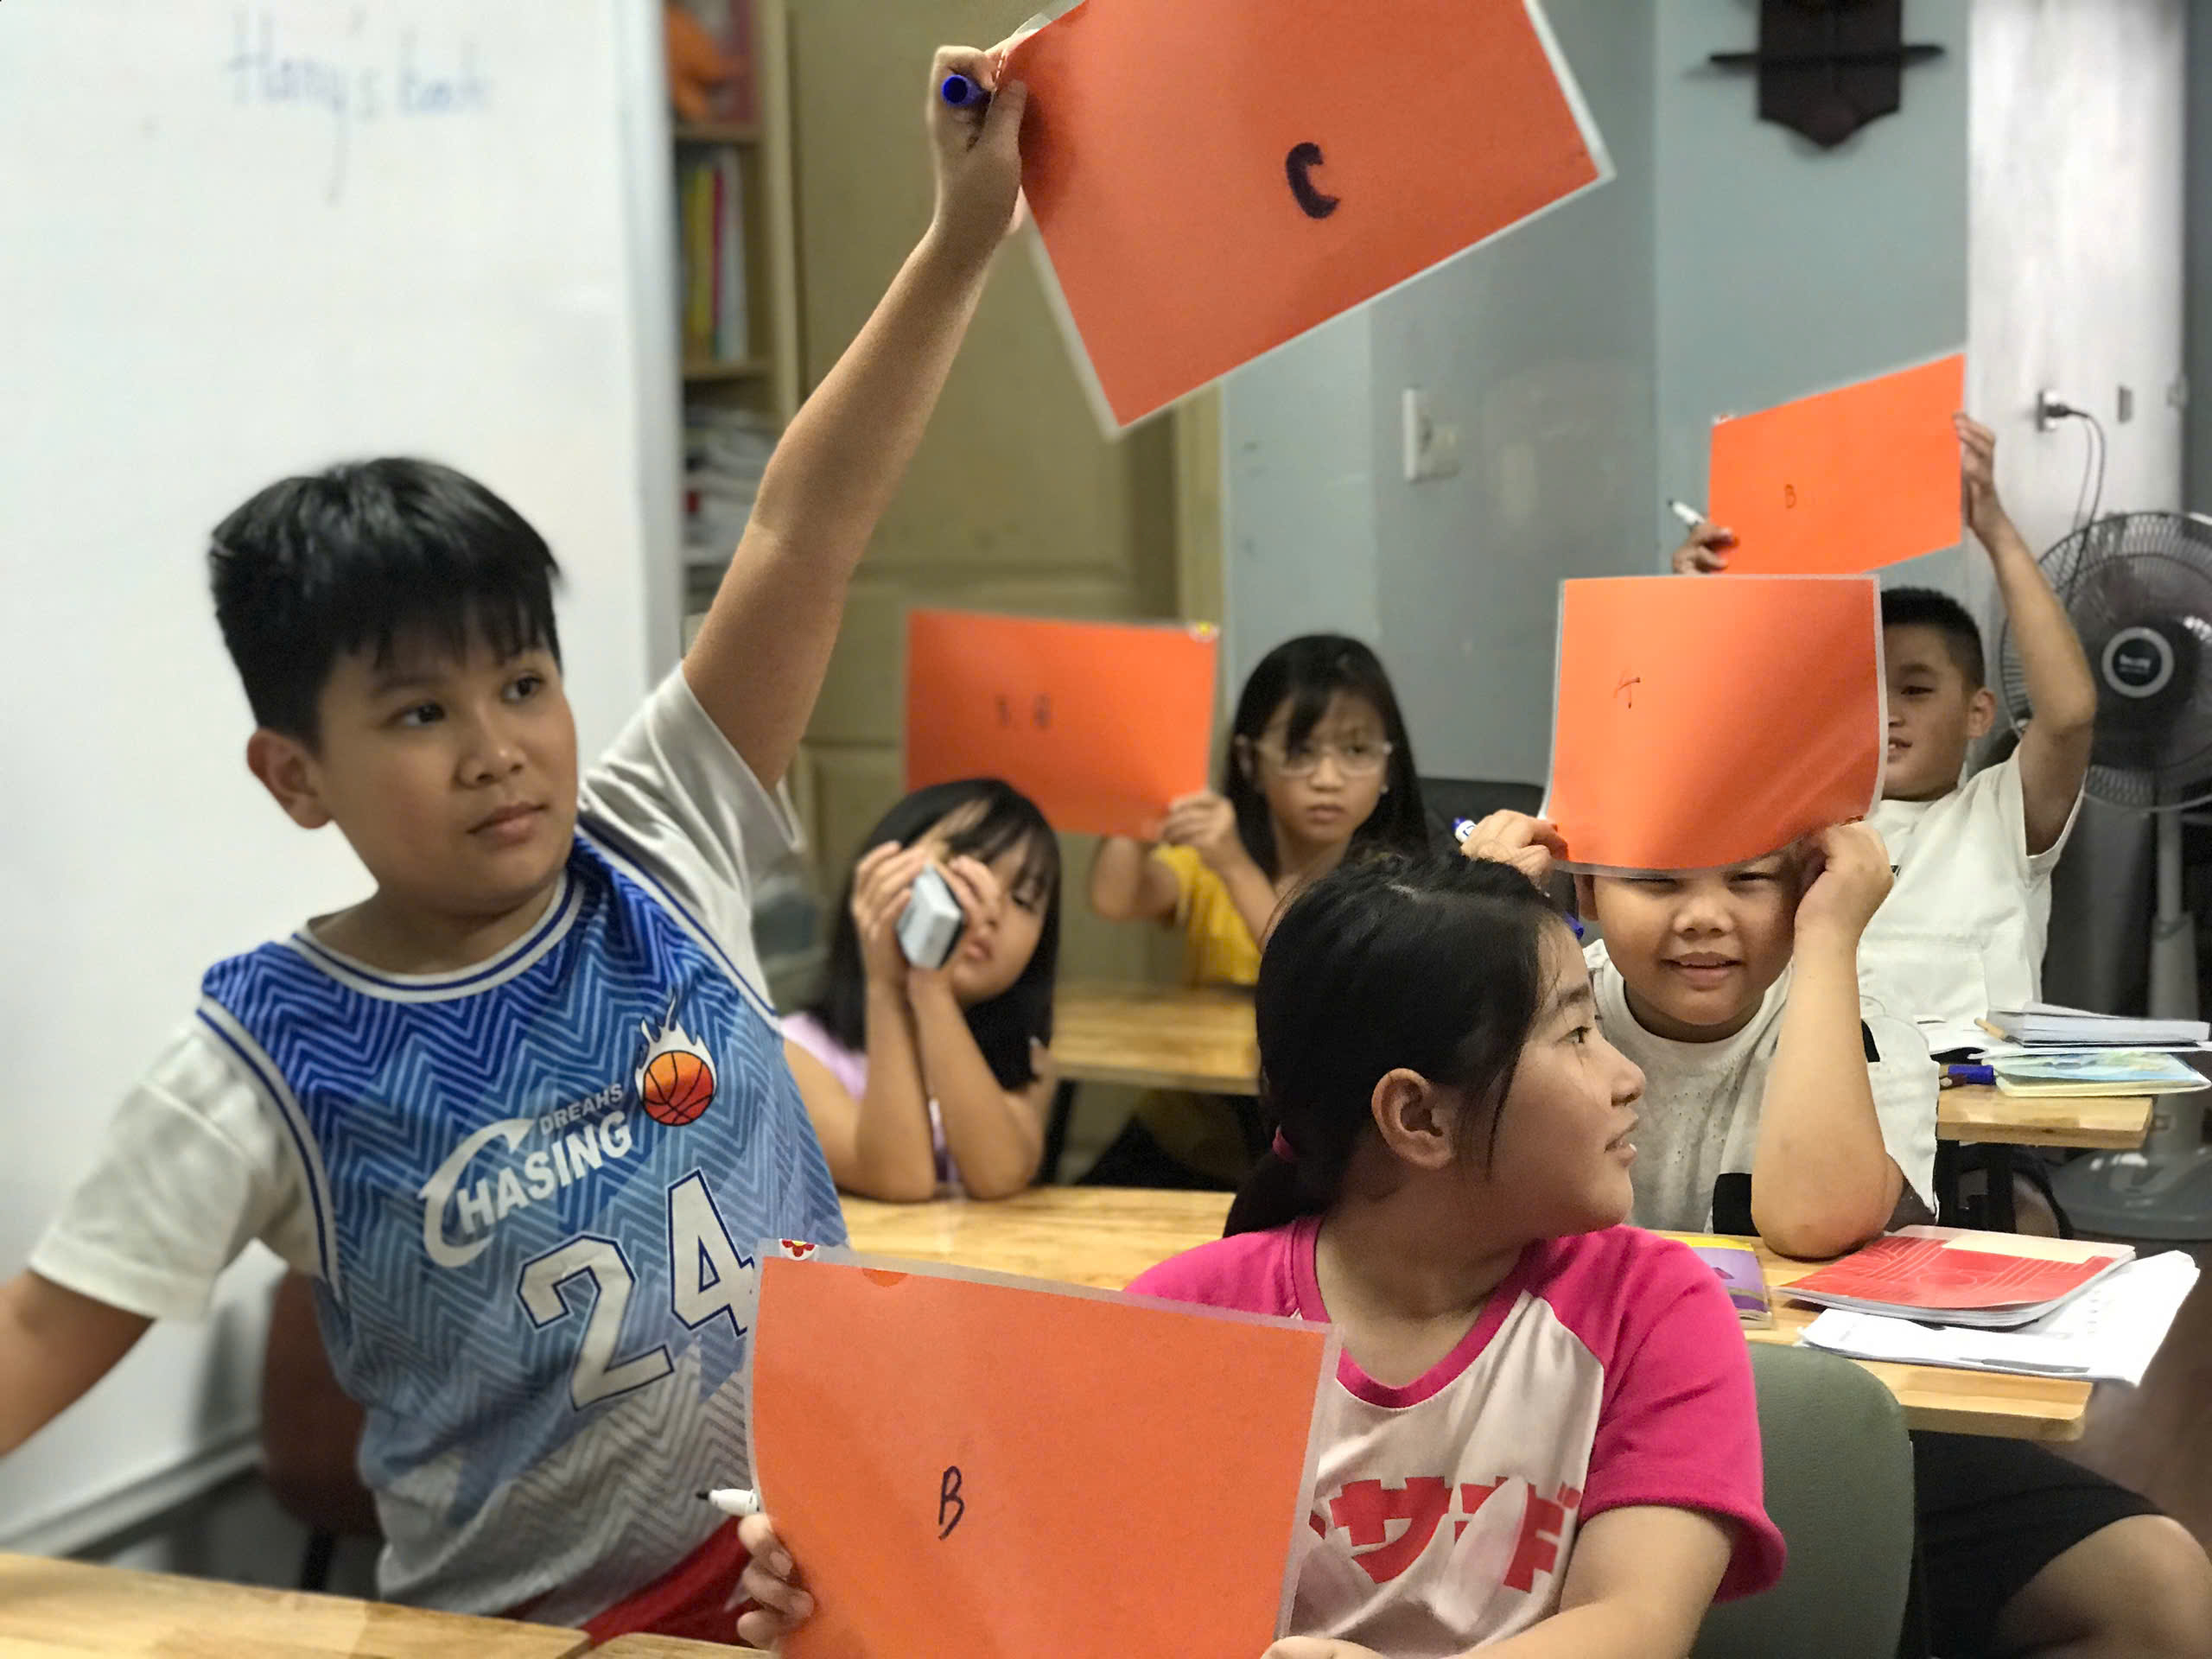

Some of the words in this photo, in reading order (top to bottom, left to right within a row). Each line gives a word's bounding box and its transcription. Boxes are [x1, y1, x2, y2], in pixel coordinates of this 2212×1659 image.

[1286, 142, 1341, 219] C
[1784, 484, 1796, 510] B
[416, 1110, 632, 1268] CHASING
[516, 1166, 754, 1413] 24
[938, 1465, 965, 1541] B
